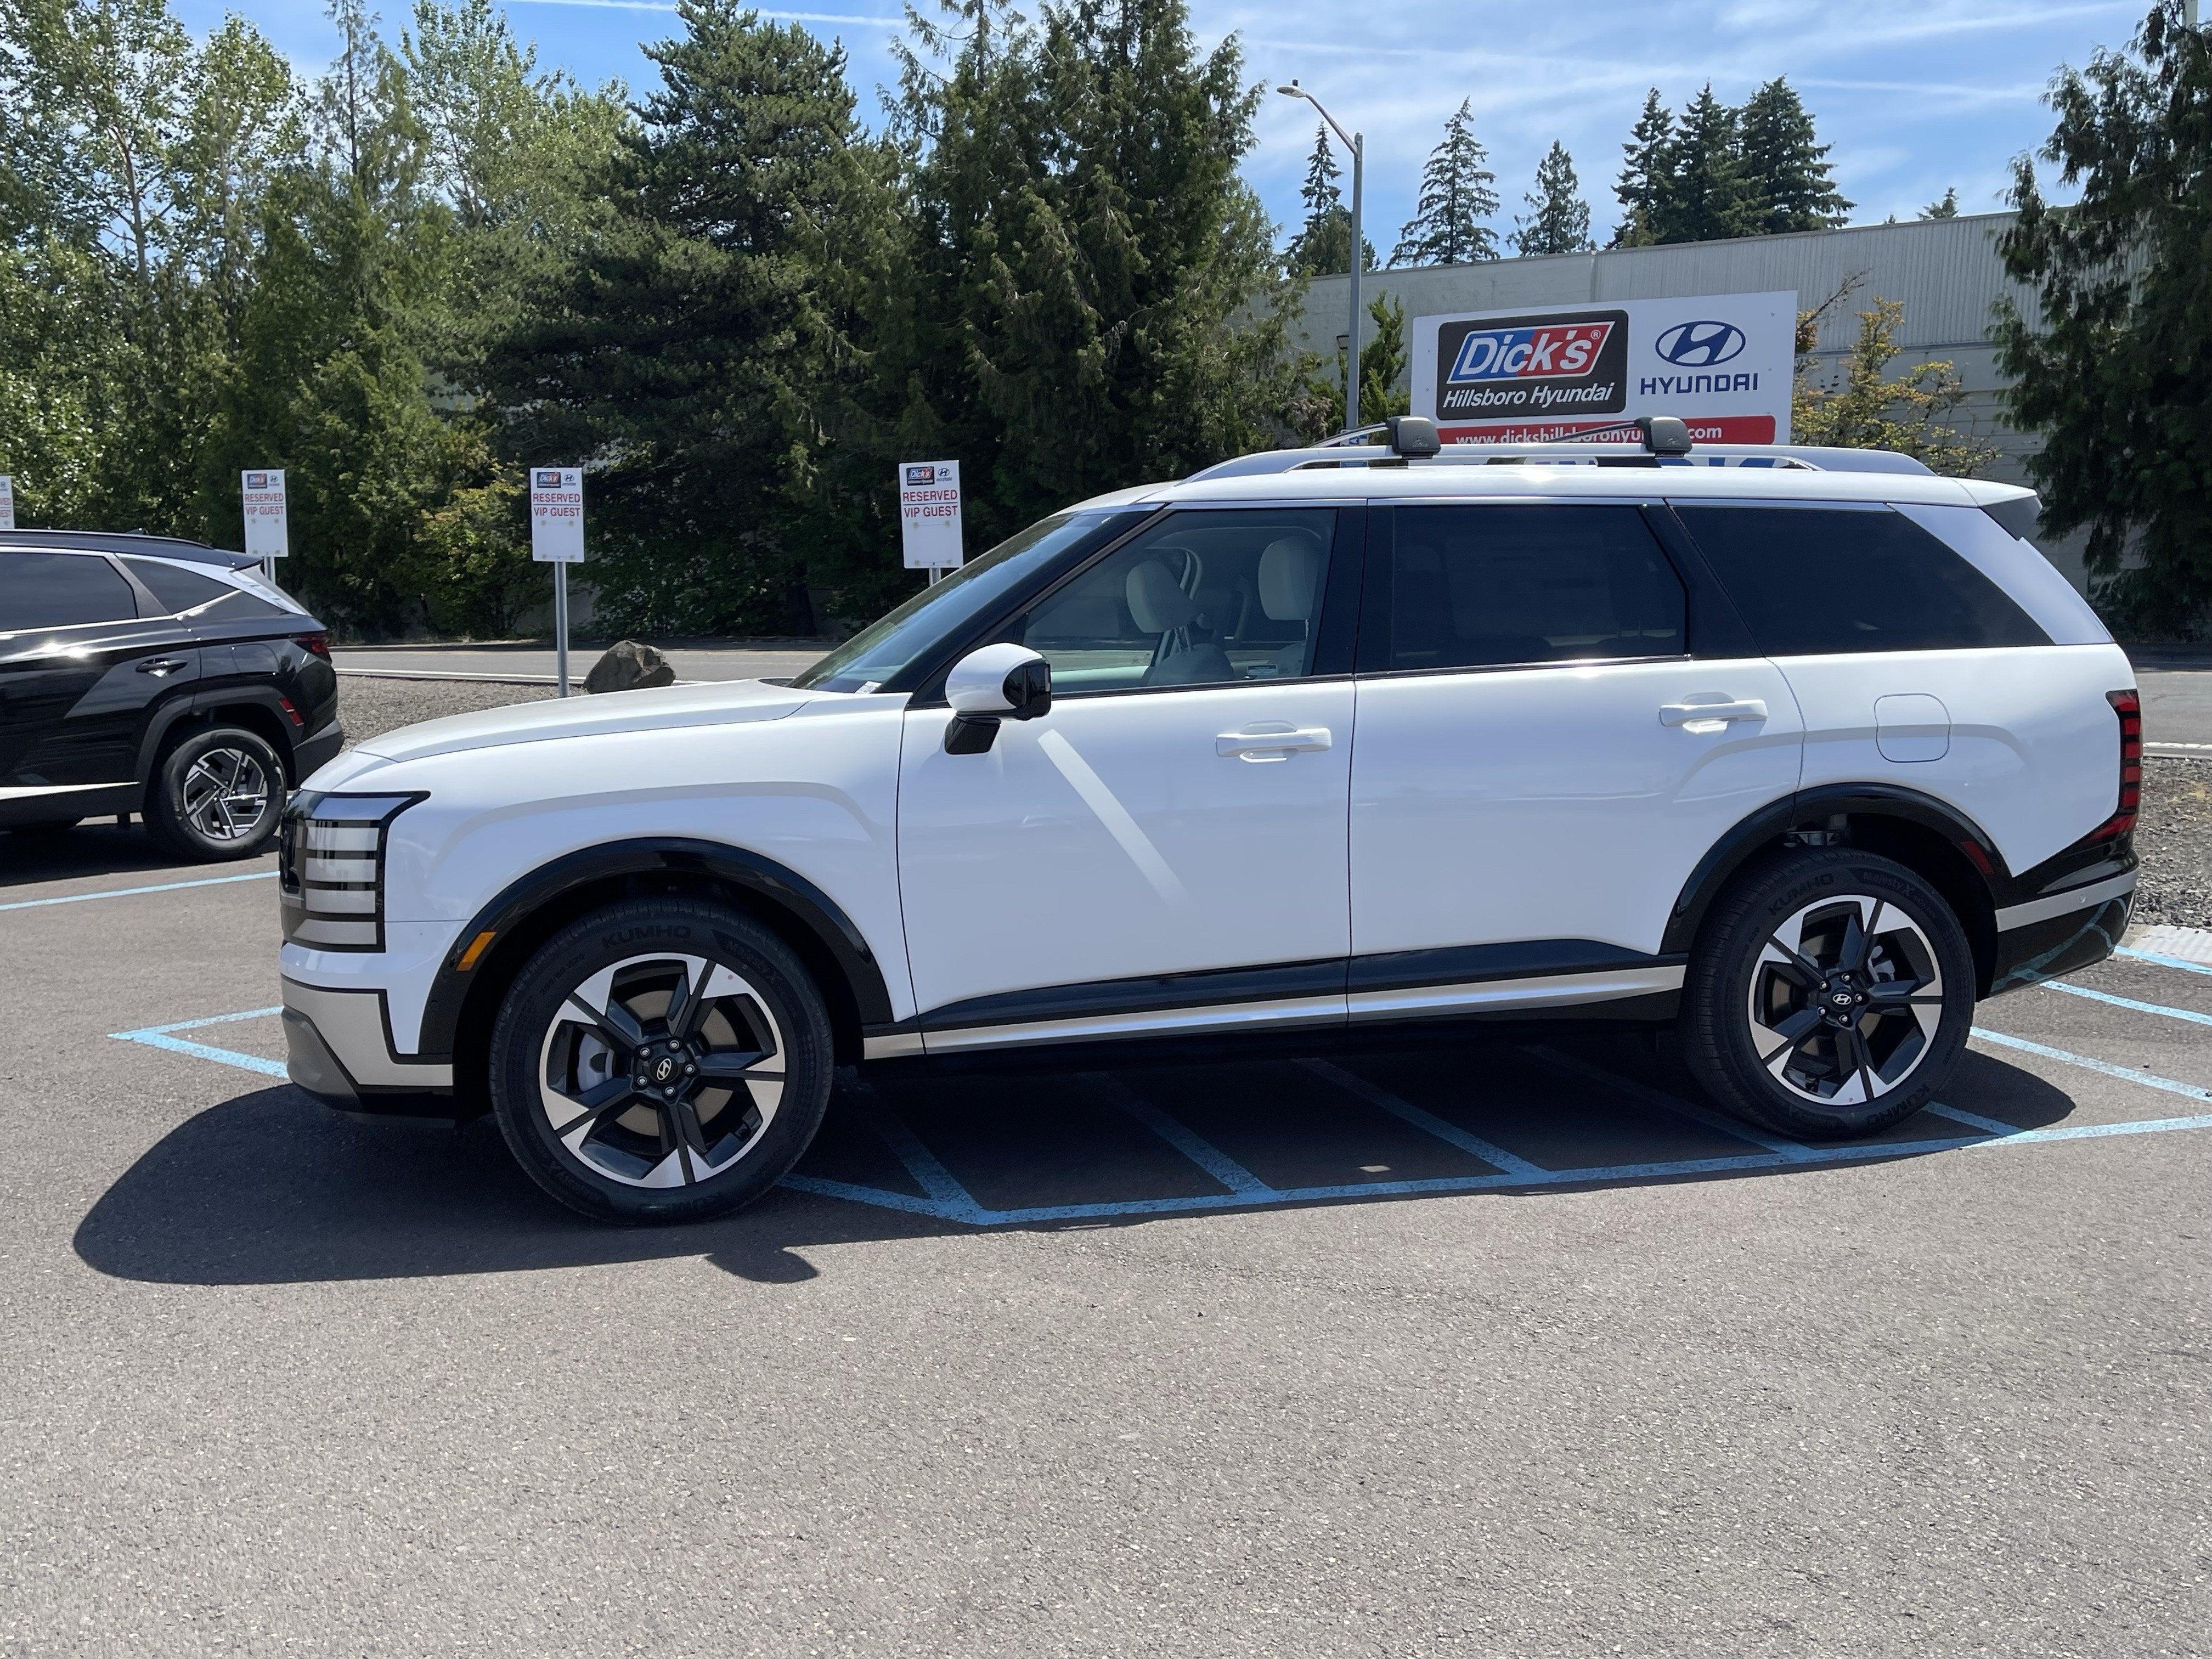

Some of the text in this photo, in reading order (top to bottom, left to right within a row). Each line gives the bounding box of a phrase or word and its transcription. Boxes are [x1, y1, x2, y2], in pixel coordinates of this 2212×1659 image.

[1459, 330, 1592, 375] Dick's
[1640, 373, 1758, 396] HYUNDAI
[1442, 382, 1615, 408] Hillsboro Hyundai
[245, 493, 284, 502] RESERVED
[533, 493, 580, 503] RESERVED
[902, 489, 957, 502] RESERVED
[245, 506, 284, 515] VIP GUEST
[534, 507, 580, 517] VIP GUEST
[904, 505, 958, 517] VIP GUEST
[1768, 873, 1835, 916] KUMHO
[602, 925, 692, 949] KUMHO
